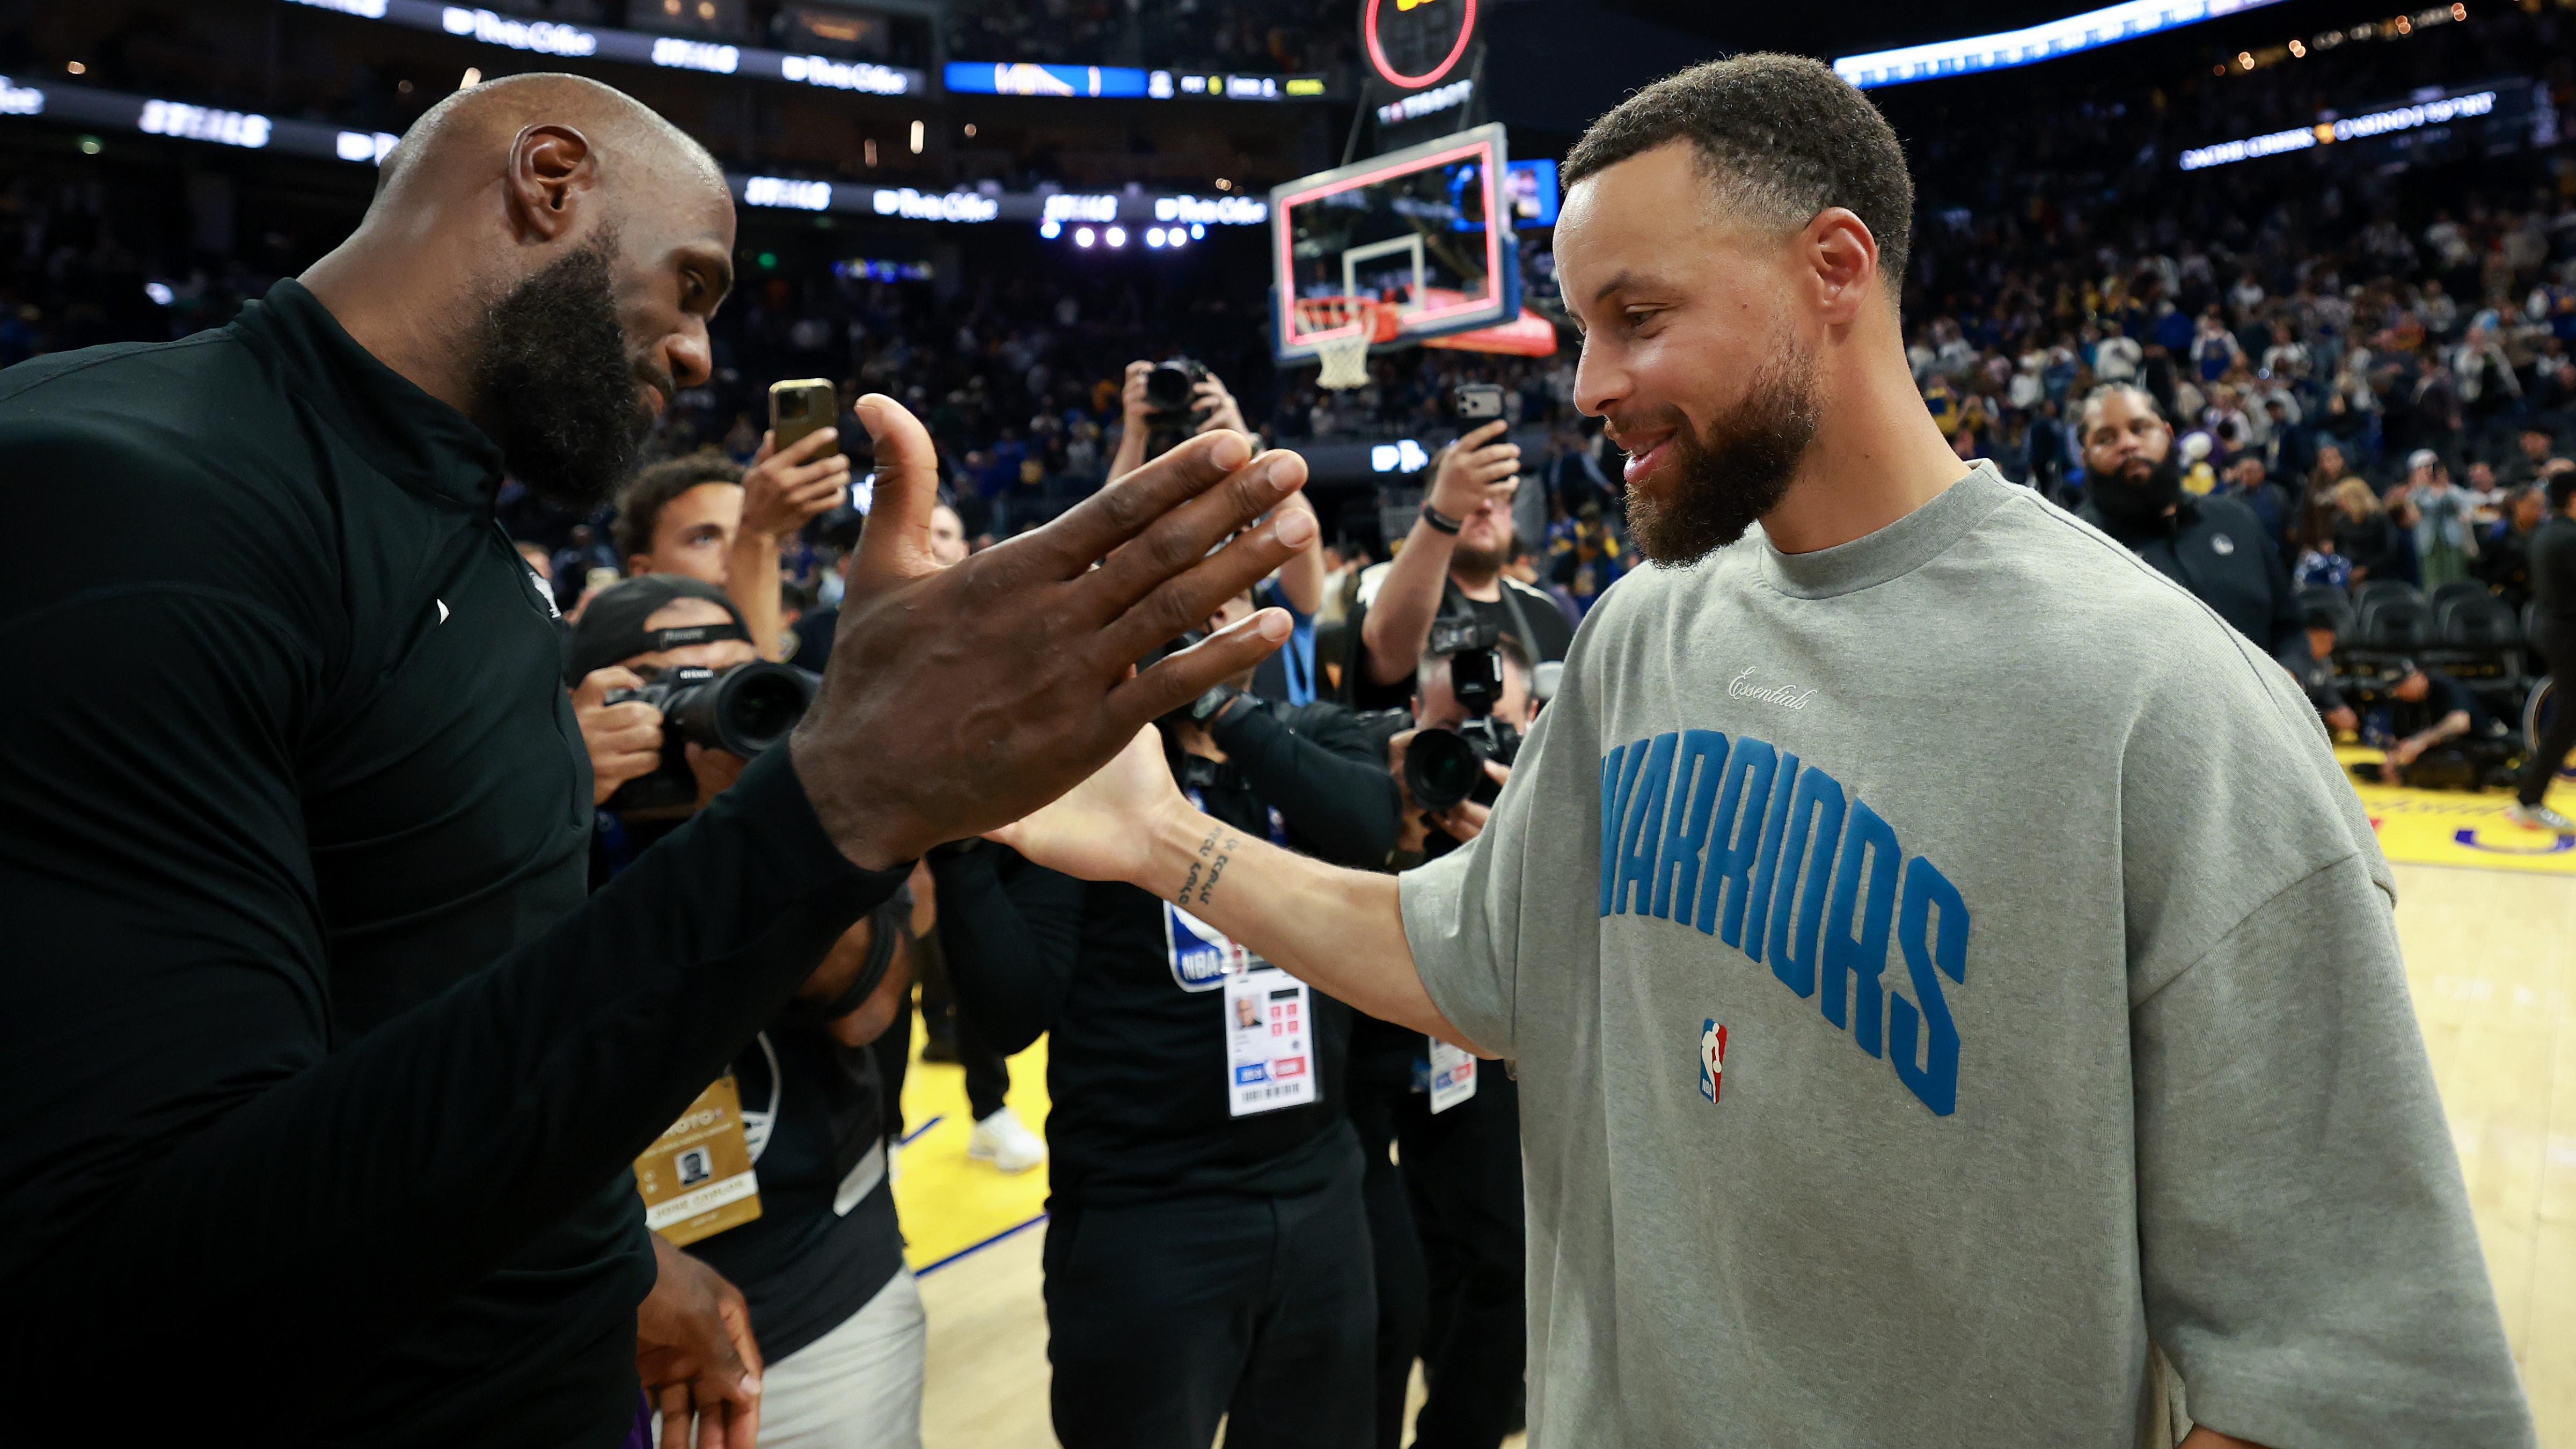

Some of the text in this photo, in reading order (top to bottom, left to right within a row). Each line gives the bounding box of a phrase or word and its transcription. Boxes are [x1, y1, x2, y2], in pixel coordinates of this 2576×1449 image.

[1729, 666, 1817, 709] Essentials
[1600, 729, 1970, 1116] WARRIORS
[1182, 949, 1221, 979] NBA
[1702, 1078, 1712, 1097] NBA
